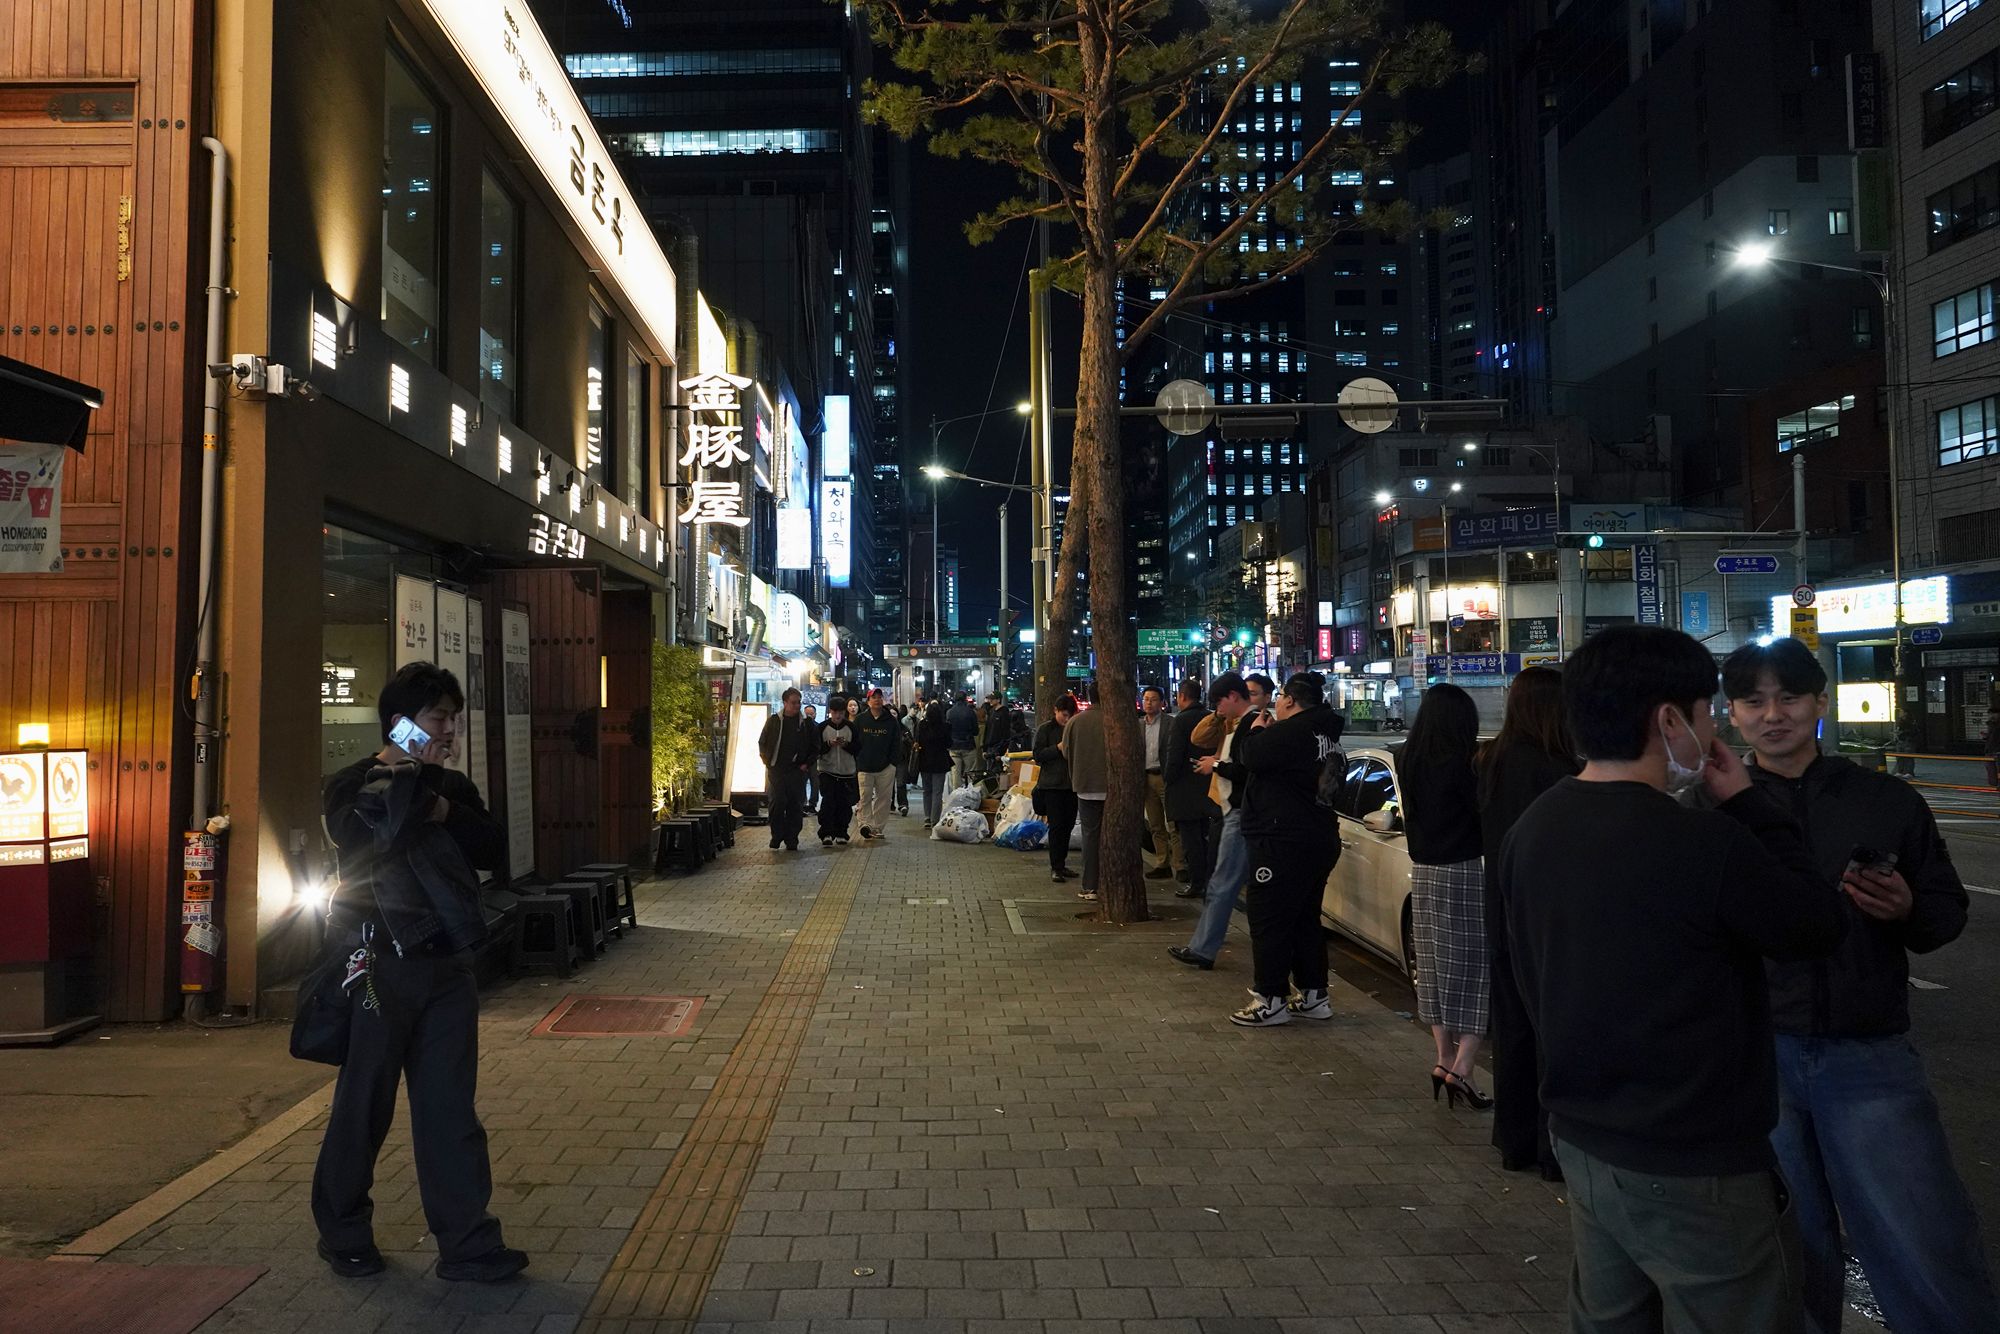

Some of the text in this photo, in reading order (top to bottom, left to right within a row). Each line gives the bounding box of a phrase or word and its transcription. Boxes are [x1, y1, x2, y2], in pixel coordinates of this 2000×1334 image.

[678, 371, 752, 527] 金豚屋
[827, 487, 846, 549] 청와옥
[1583, 517, 1628, 532] 아이생각
[1, 526, 47, 540] HONGKONG
[1638, 546, 1658, 623] 삼화철물
[1797, 590, 1811, 602] 50
[405, 620, 427, 648] 한우
